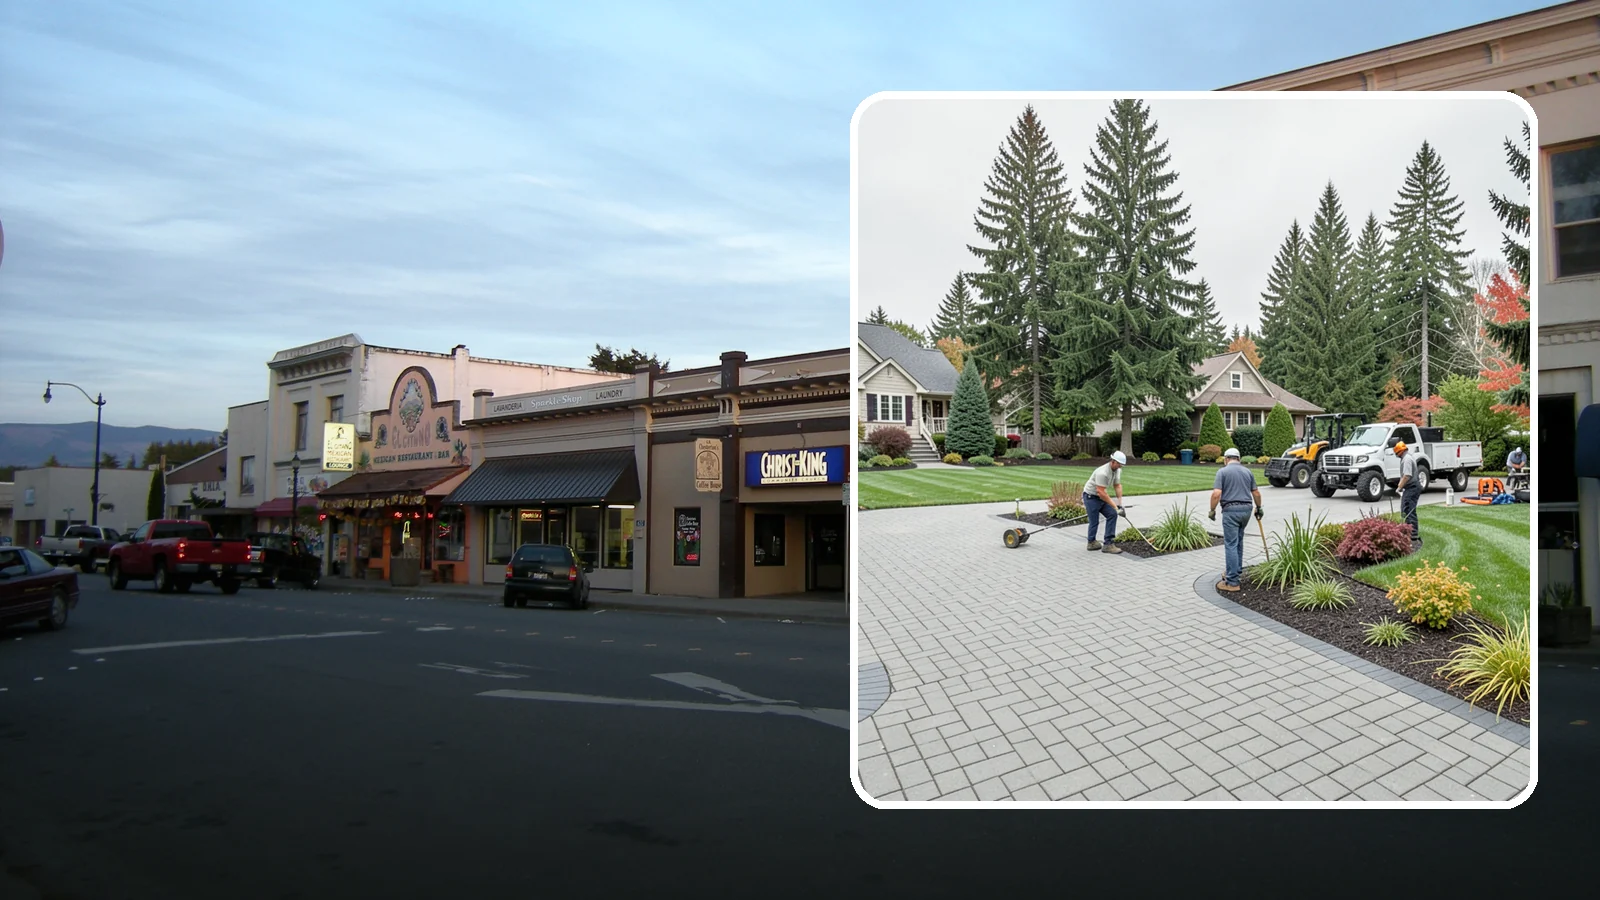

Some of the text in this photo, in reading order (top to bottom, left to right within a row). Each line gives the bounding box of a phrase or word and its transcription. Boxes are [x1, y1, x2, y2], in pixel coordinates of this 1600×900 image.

[493, 389, 624, 413] LAVANDERIA Sparkle Shop LAUNDRY
[374, 454, 395, 464] MEXICAN
[398, 452, 432, 461] RESTAURANT
[438, 450, 449, 460] BAR
[761, 450, 828, 478] CHRIST KING
